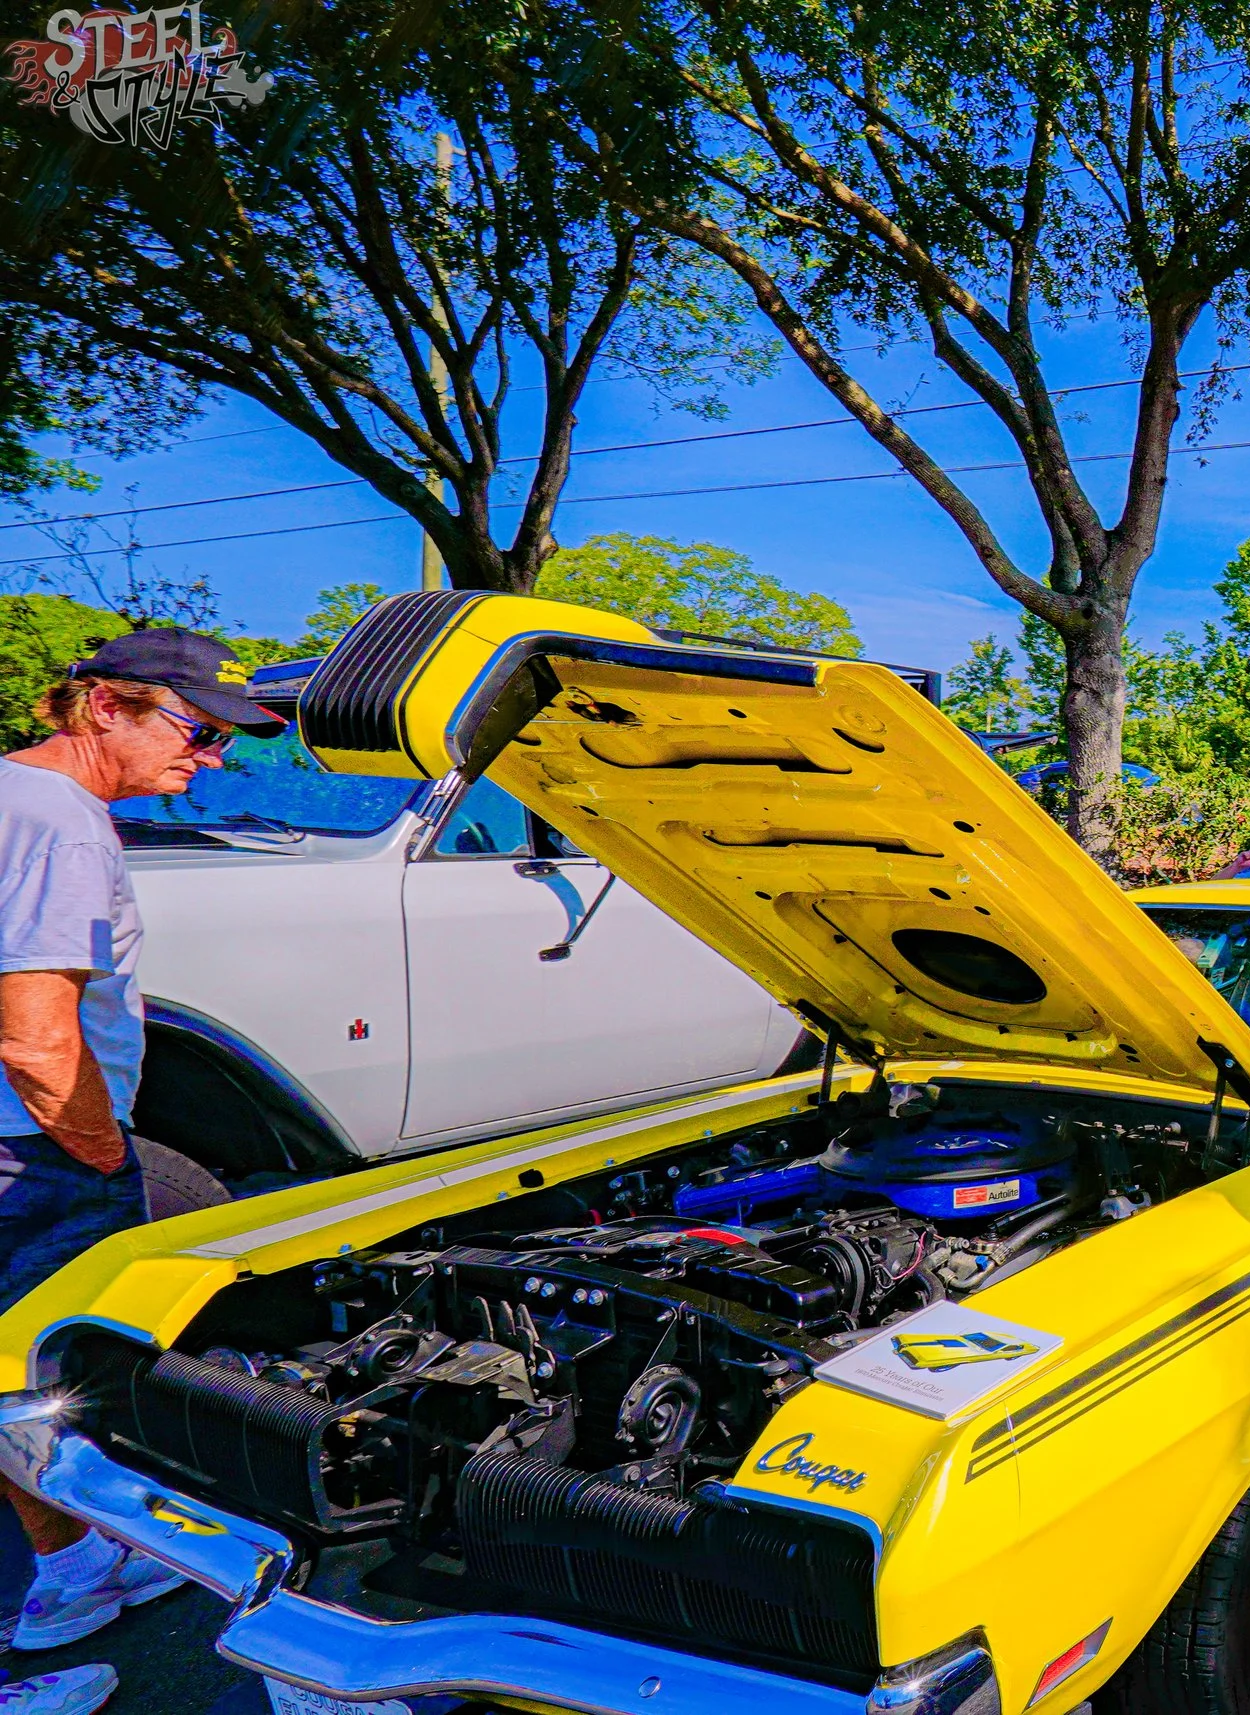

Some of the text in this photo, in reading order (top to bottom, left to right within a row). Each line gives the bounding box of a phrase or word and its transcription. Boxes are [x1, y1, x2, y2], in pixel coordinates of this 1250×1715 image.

[988, 1189, 1018, 1201] Autolite
[870, 1366, 945, 1395] 25 Years of Our
[756, 1432, 868, 1493] Cougar
